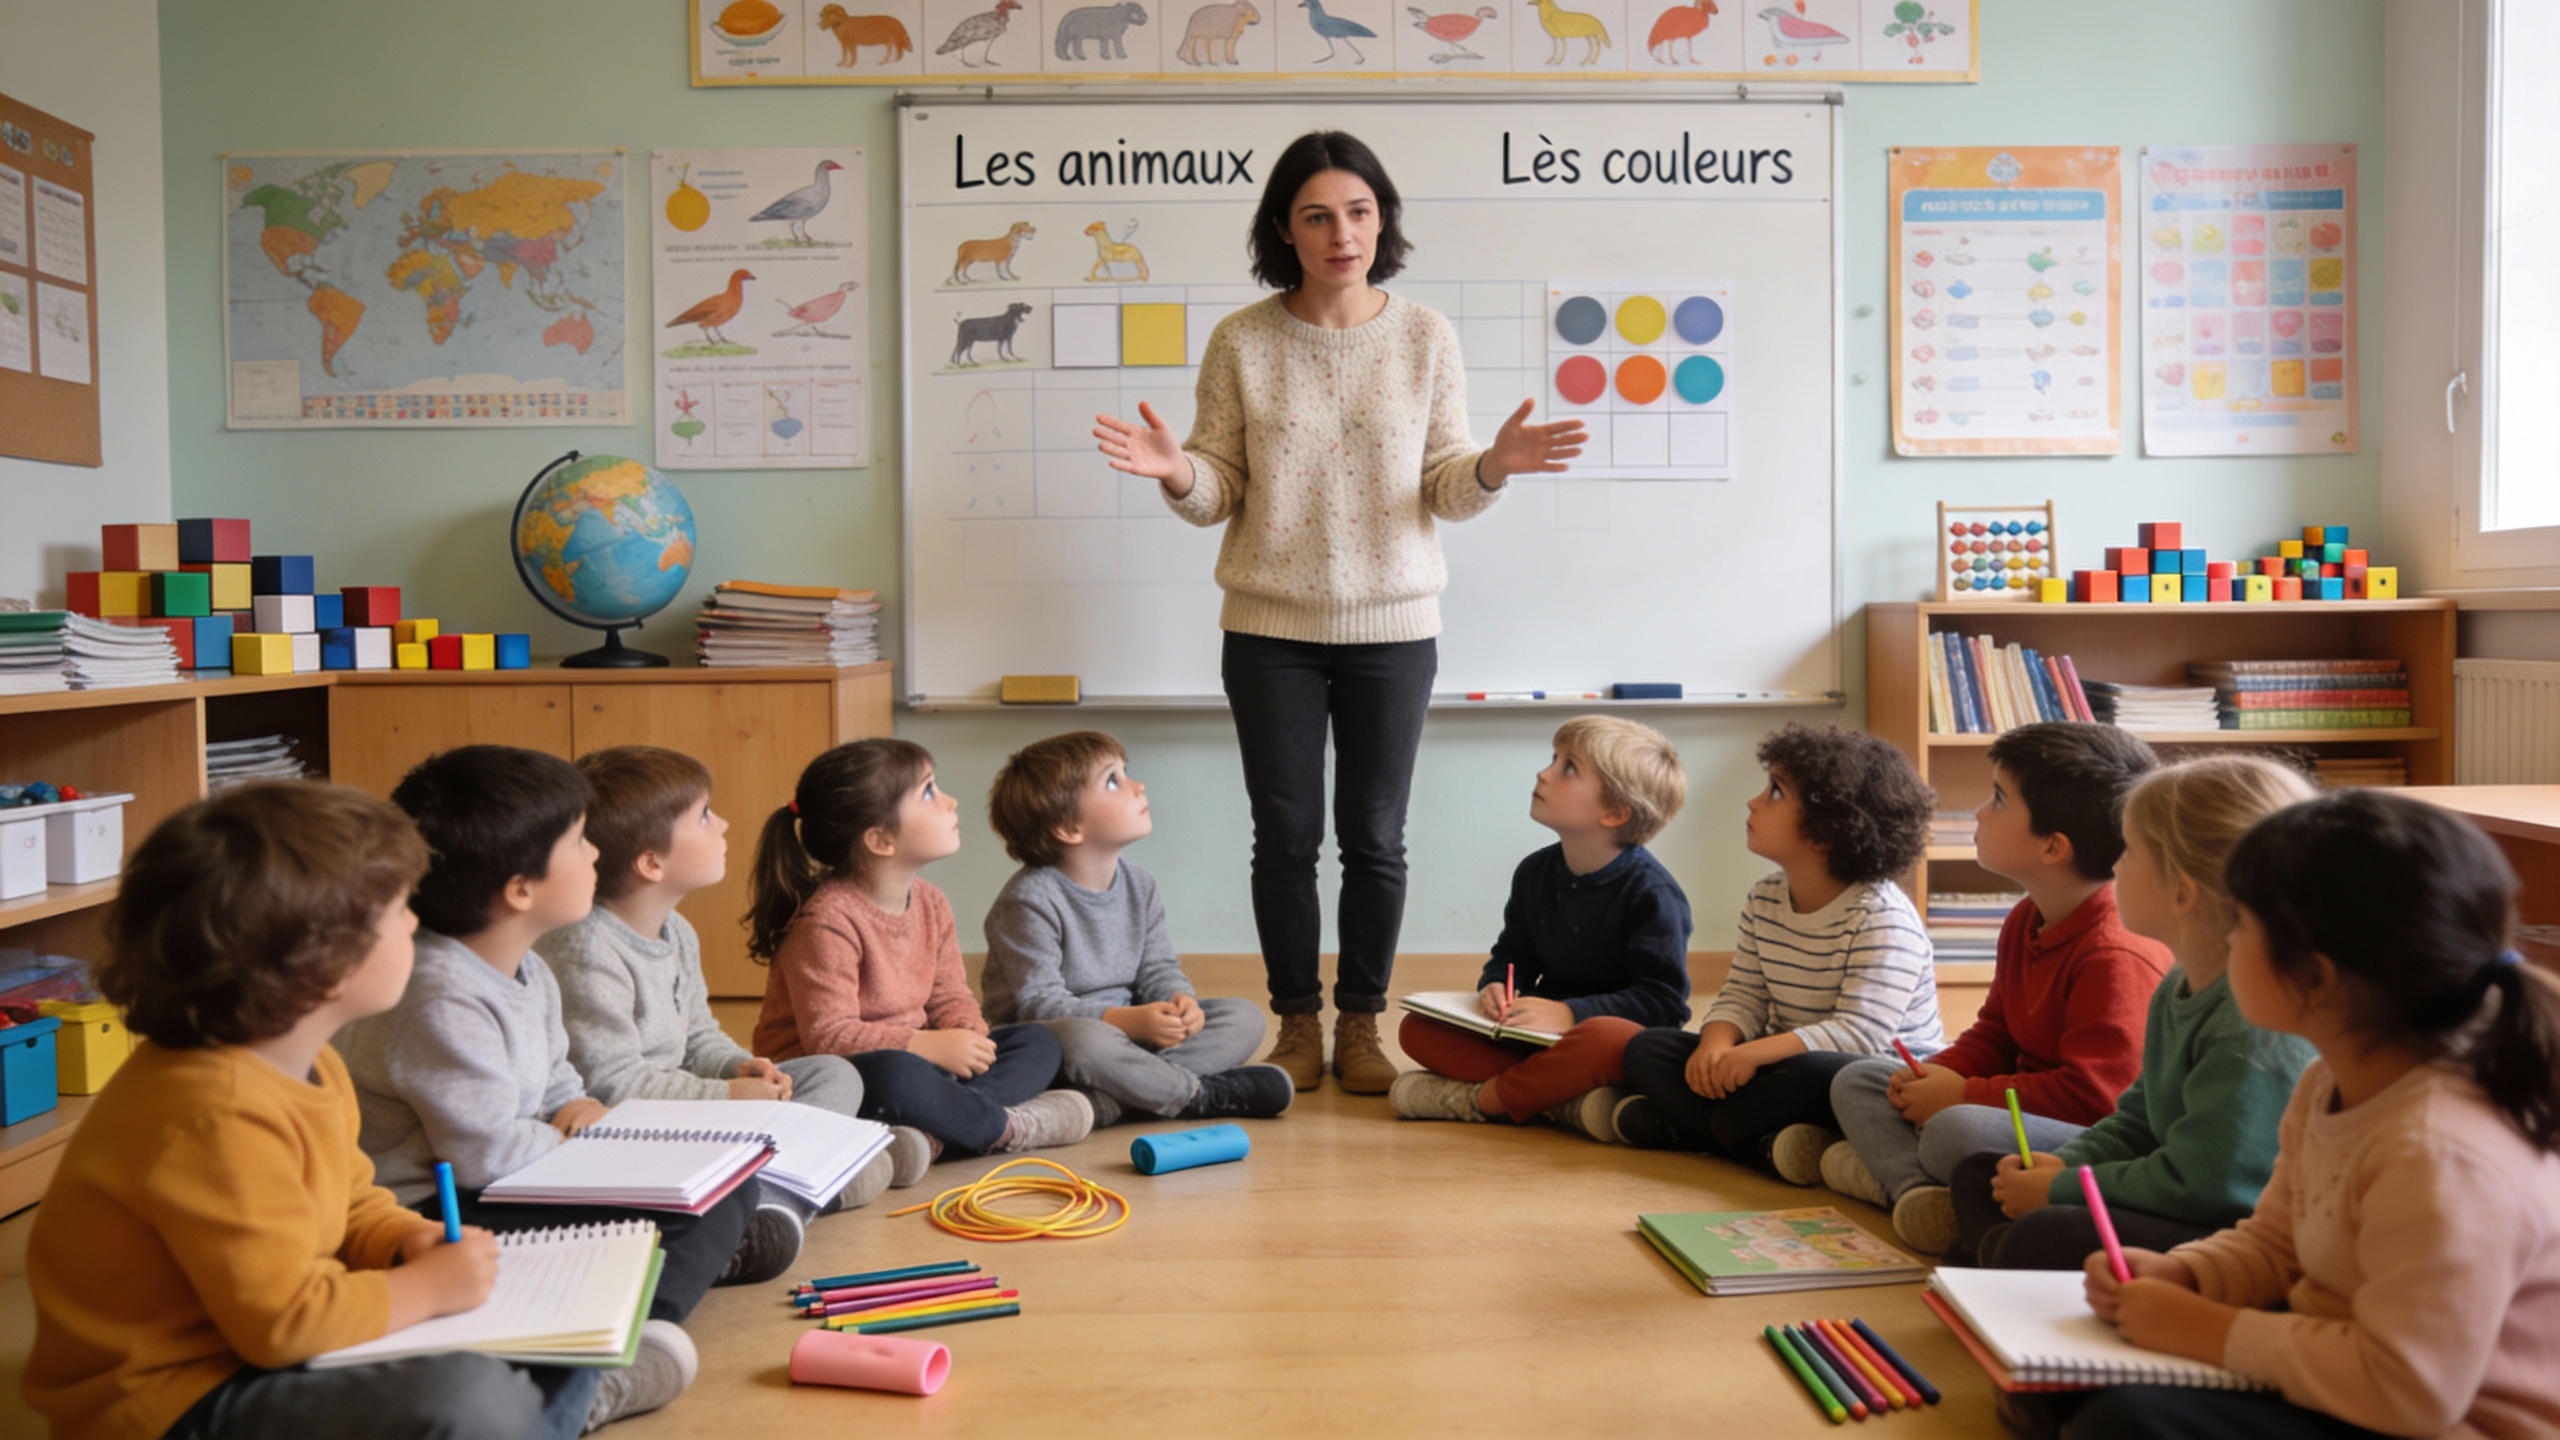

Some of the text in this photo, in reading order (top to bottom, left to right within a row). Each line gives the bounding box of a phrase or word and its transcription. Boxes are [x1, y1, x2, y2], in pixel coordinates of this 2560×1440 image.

[955, 133, 1253, 190] Les animaux
[1503, 131, 1792, 185] Lès couleurs
